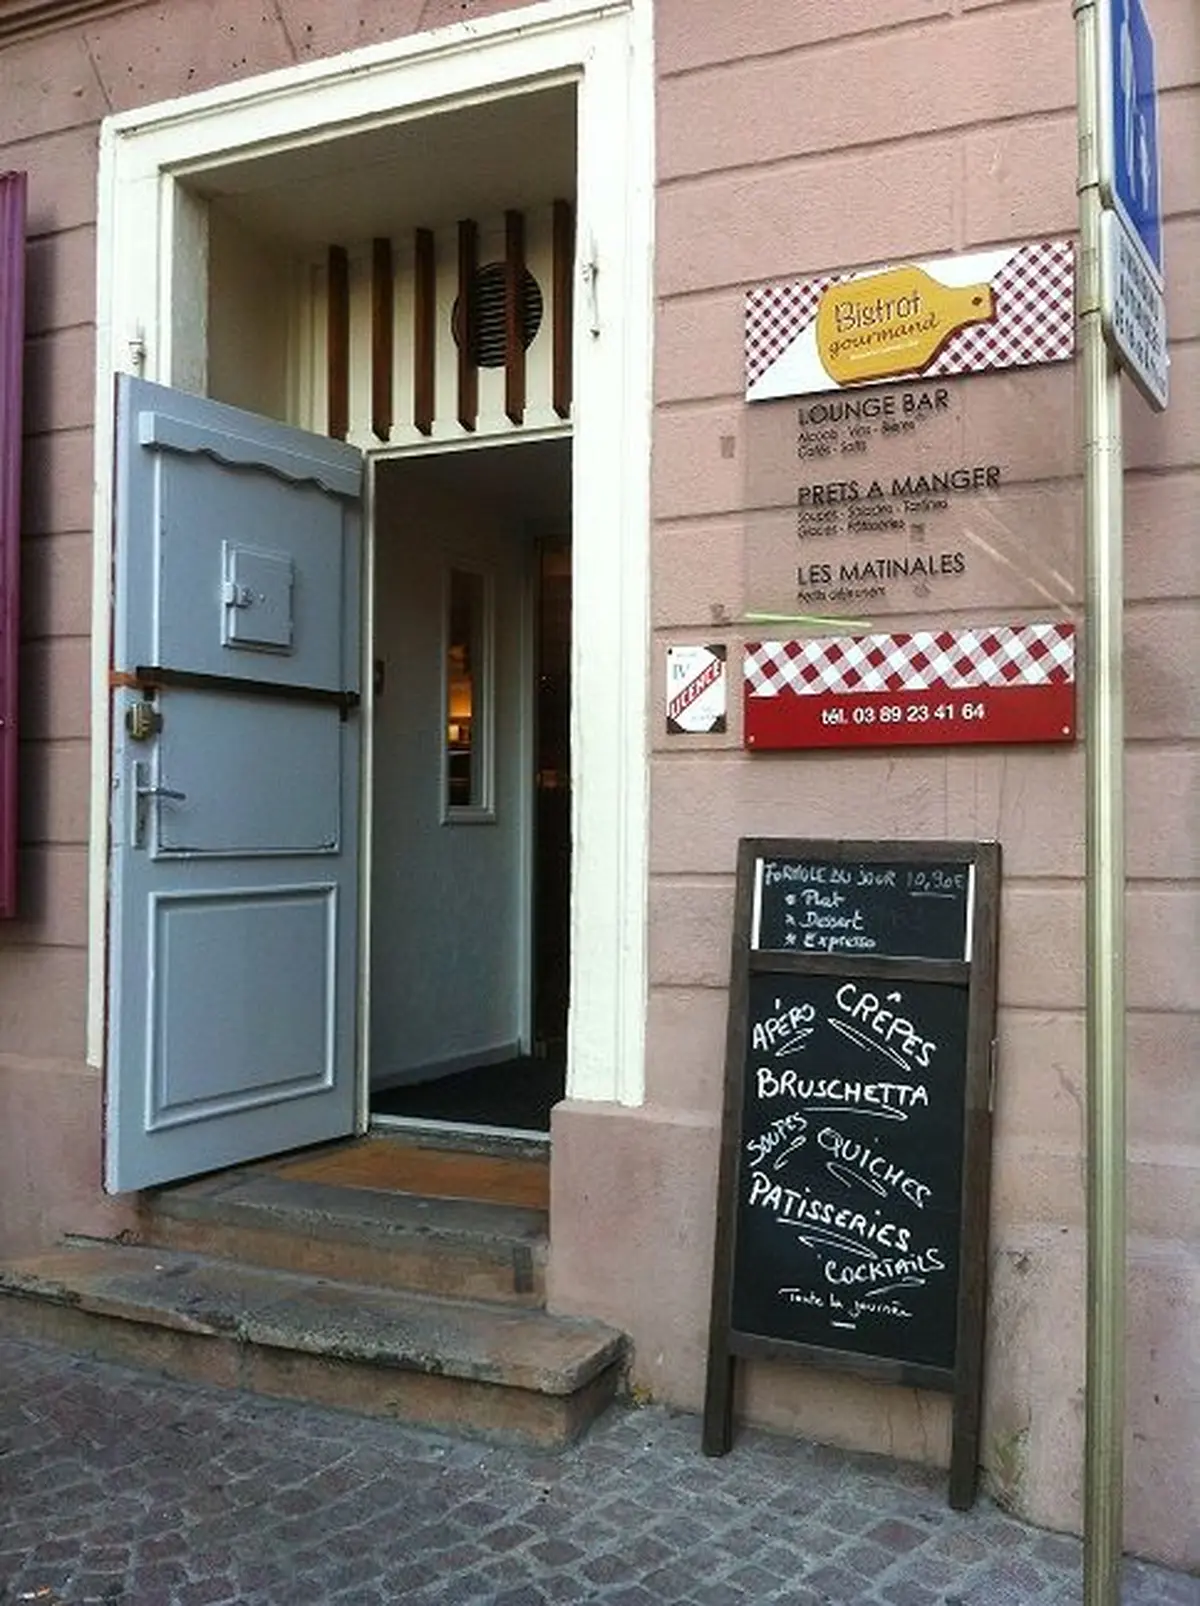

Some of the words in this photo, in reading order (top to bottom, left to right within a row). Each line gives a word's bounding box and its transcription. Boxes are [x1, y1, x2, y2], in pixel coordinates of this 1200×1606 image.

[834, 288, 921, 333] Bistrot
[829, 312, 941, 360] gourmand
[799, 395, 895, 425] LOUNGE
[903, 389, 949, 412] BAR
[798, 480, 859, 505] PRETS
[867, 481, 884, 500] A
[892, 466, 1001, 496] MANGER
[797, 563, 832, 586] LES
[840, 552, 966, 582] MATINALES
[670, 660, 721, 720] LICENCE
[821, 708, 849, 725] tél.
[853, 707, 876, 724] 03
[879, 705, 901, 723] 89
[906, 704, 929, 722] 23
[933, 703, 954, 720] 41
[961, 702, 985, 720] 64
[801, 888, 846, 908] Plat
[798, 909, 864, 930] Dessert
[803, 931, 876, 951] Expresso
[836, 983, 937, 1068] CRÊPES
[756, 1067, 929, 1107] BRUSCHETTA
